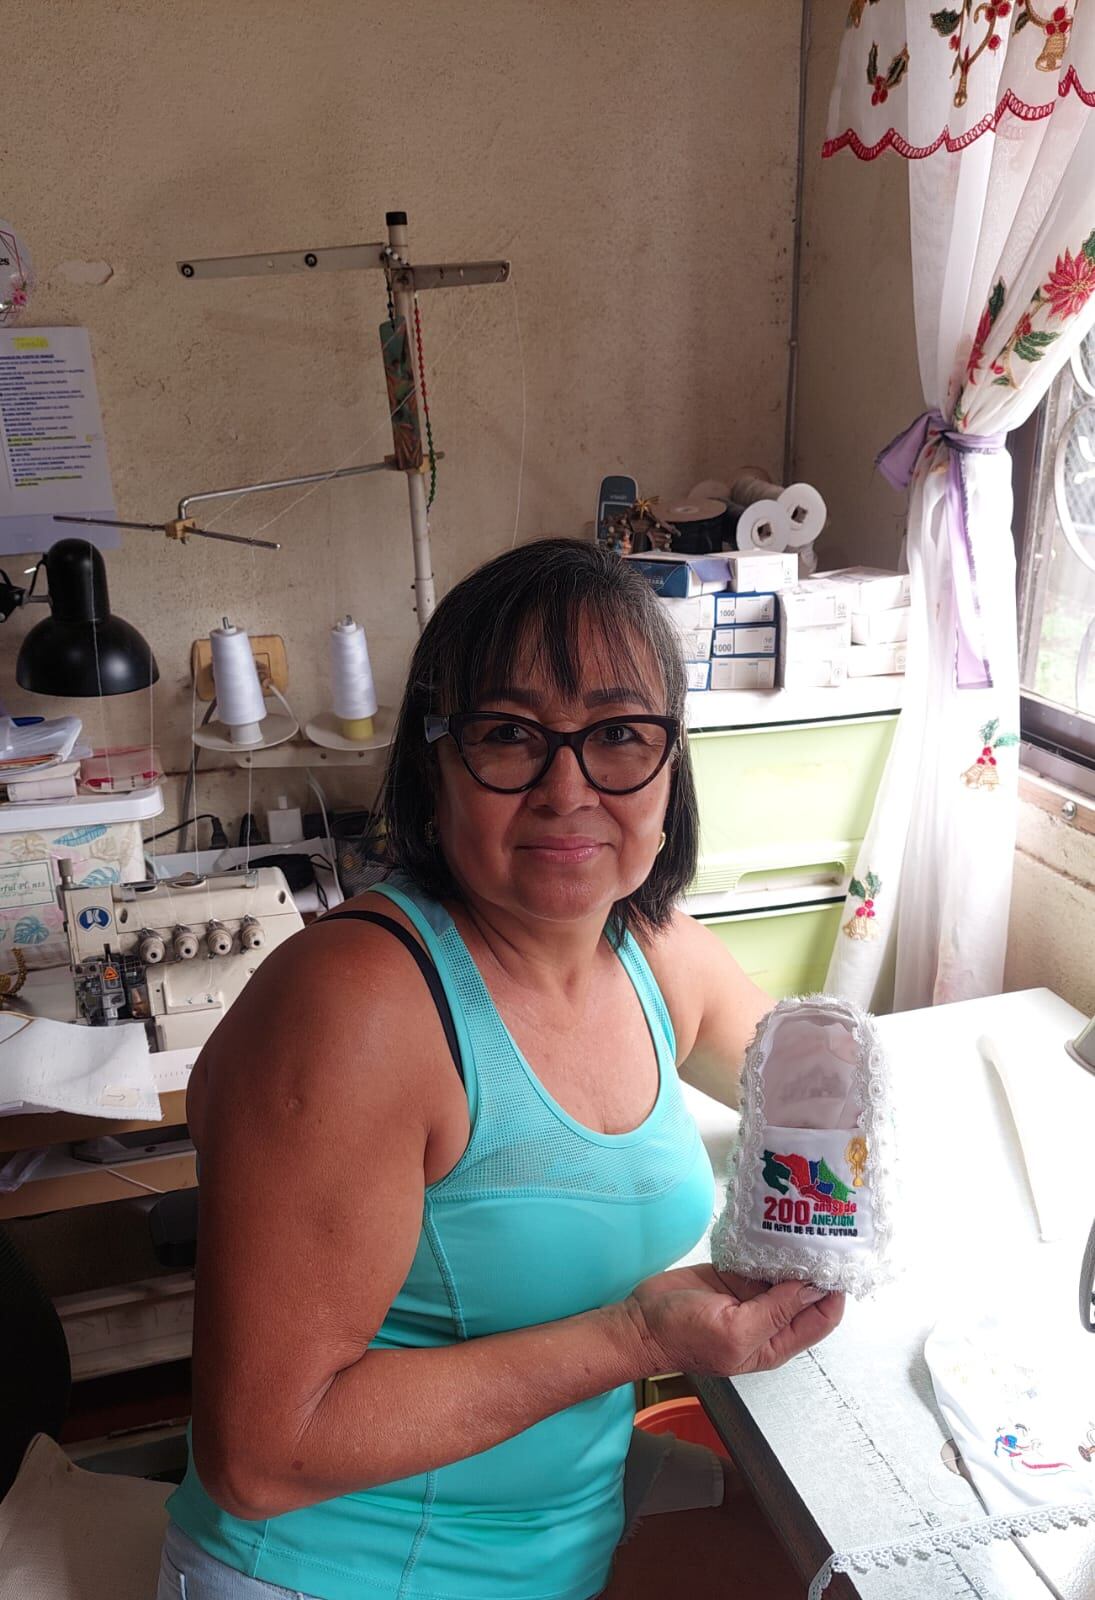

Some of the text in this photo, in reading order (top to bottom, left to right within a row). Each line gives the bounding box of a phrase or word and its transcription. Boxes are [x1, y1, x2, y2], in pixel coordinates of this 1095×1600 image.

[720, 609, 735, 617] 1000
[763, 1196, 811, 1225] 200
[774, 1223, 792, 1233] RETO
[794, 1225, 804, 1235] DE
[805, 1226, 815, 1236] FE
[829, 1228, 858, 1238] FUTURO
